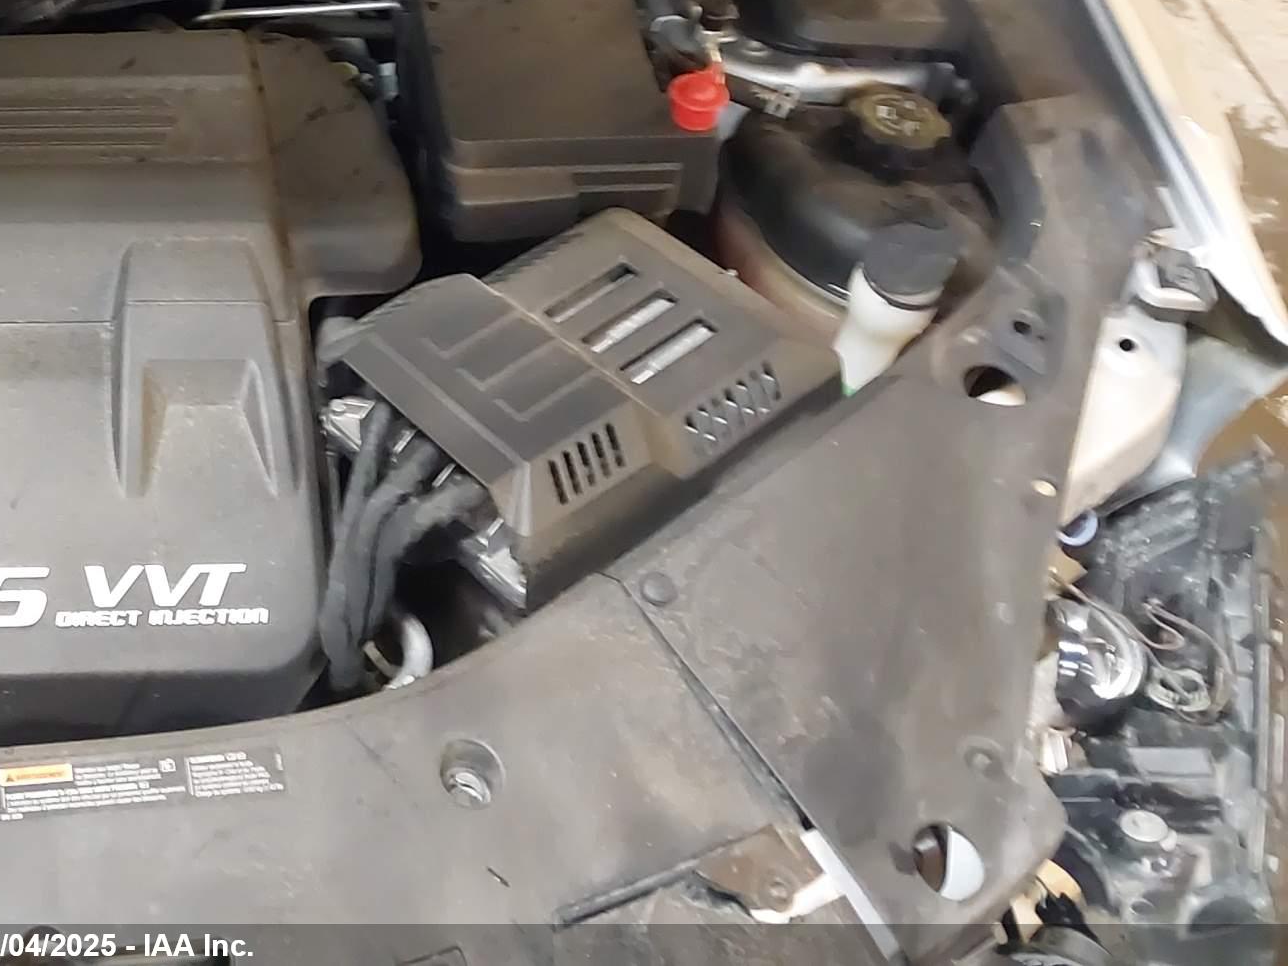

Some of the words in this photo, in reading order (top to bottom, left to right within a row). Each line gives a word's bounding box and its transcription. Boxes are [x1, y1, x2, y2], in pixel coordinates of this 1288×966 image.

[83, 562, 248, 607] VVT
[54, 609, 144, 628] DIRECT
[147, 607, 270, 626] INJECTION
